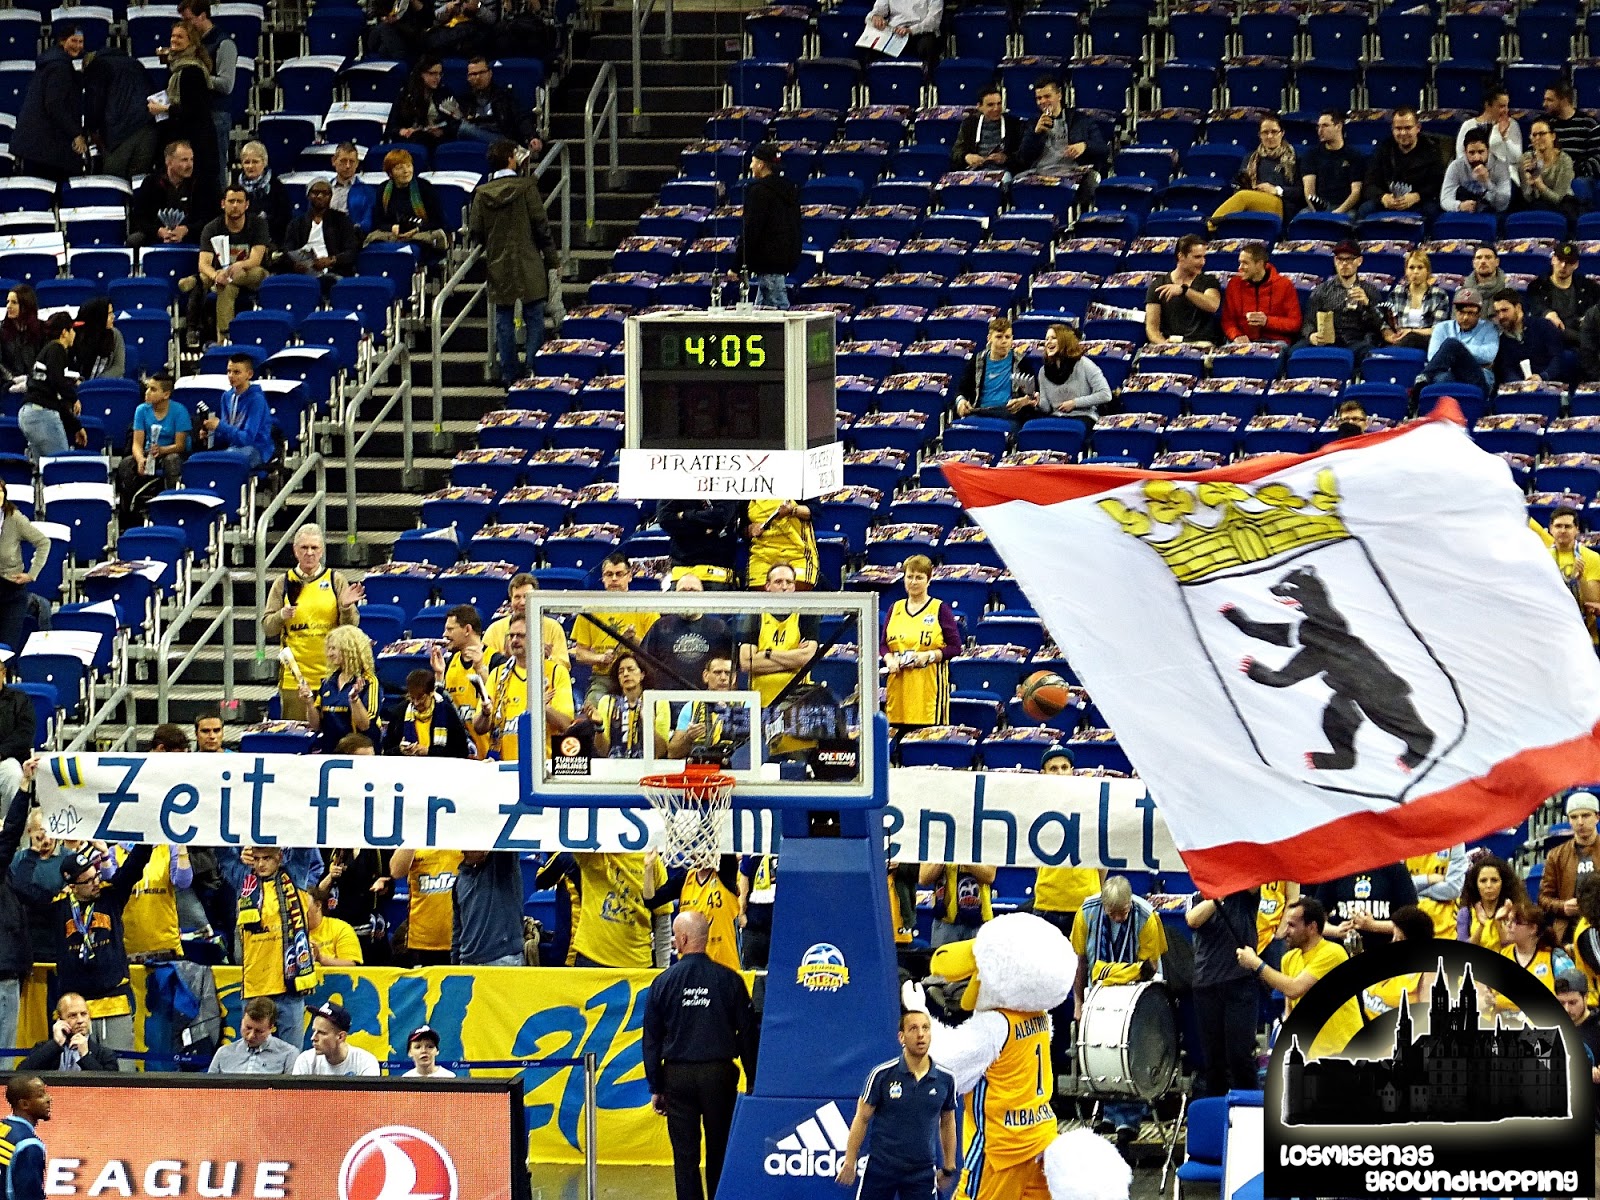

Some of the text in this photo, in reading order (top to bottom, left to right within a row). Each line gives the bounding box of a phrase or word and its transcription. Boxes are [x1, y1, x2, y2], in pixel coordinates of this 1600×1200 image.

[685, 335, 765, 367] 4:05
[647, 454, 741, 473] PIRATES
[694, 476, 774, 495] BERLIN
[919, 630, 933, 647] 15
[310, 759, 456, 847] für
[707, 891, 722, 909] 43
[682, 986, 709, 996] Service
[682, 997, 711, 1008] Security
